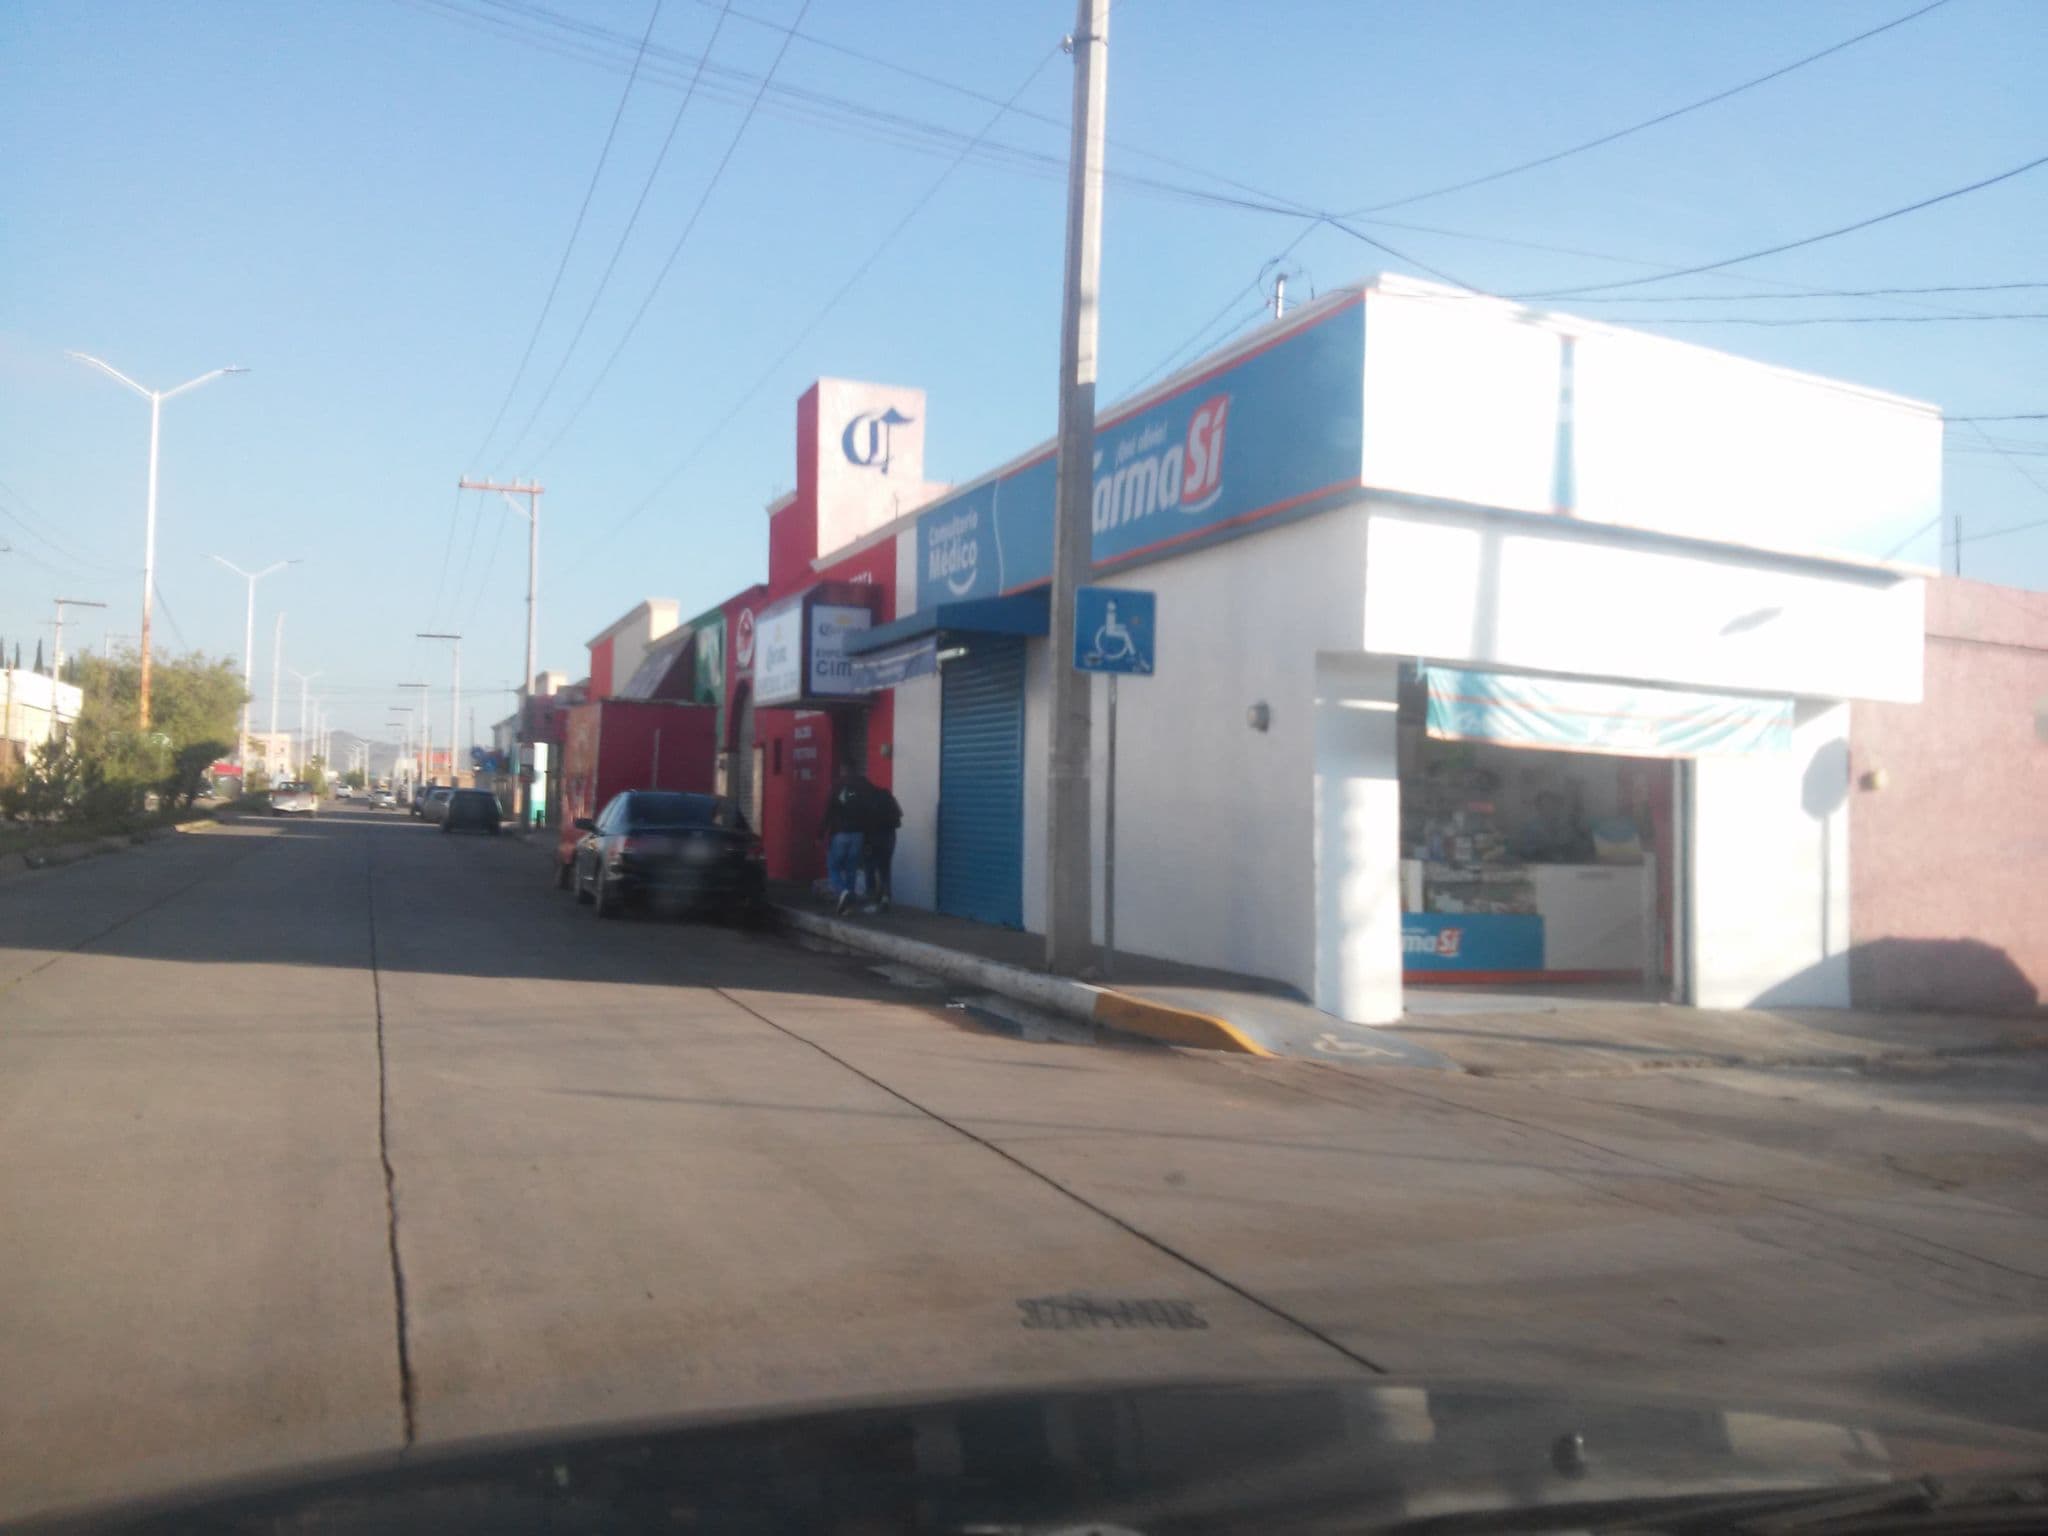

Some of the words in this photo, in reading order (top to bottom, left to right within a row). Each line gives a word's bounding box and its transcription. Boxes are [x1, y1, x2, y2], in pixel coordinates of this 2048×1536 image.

[1091, 398, 1228, 536] armaSí
[927, 537, 979, 581] Médico
[1401, 928, 1459, 952] maSí
